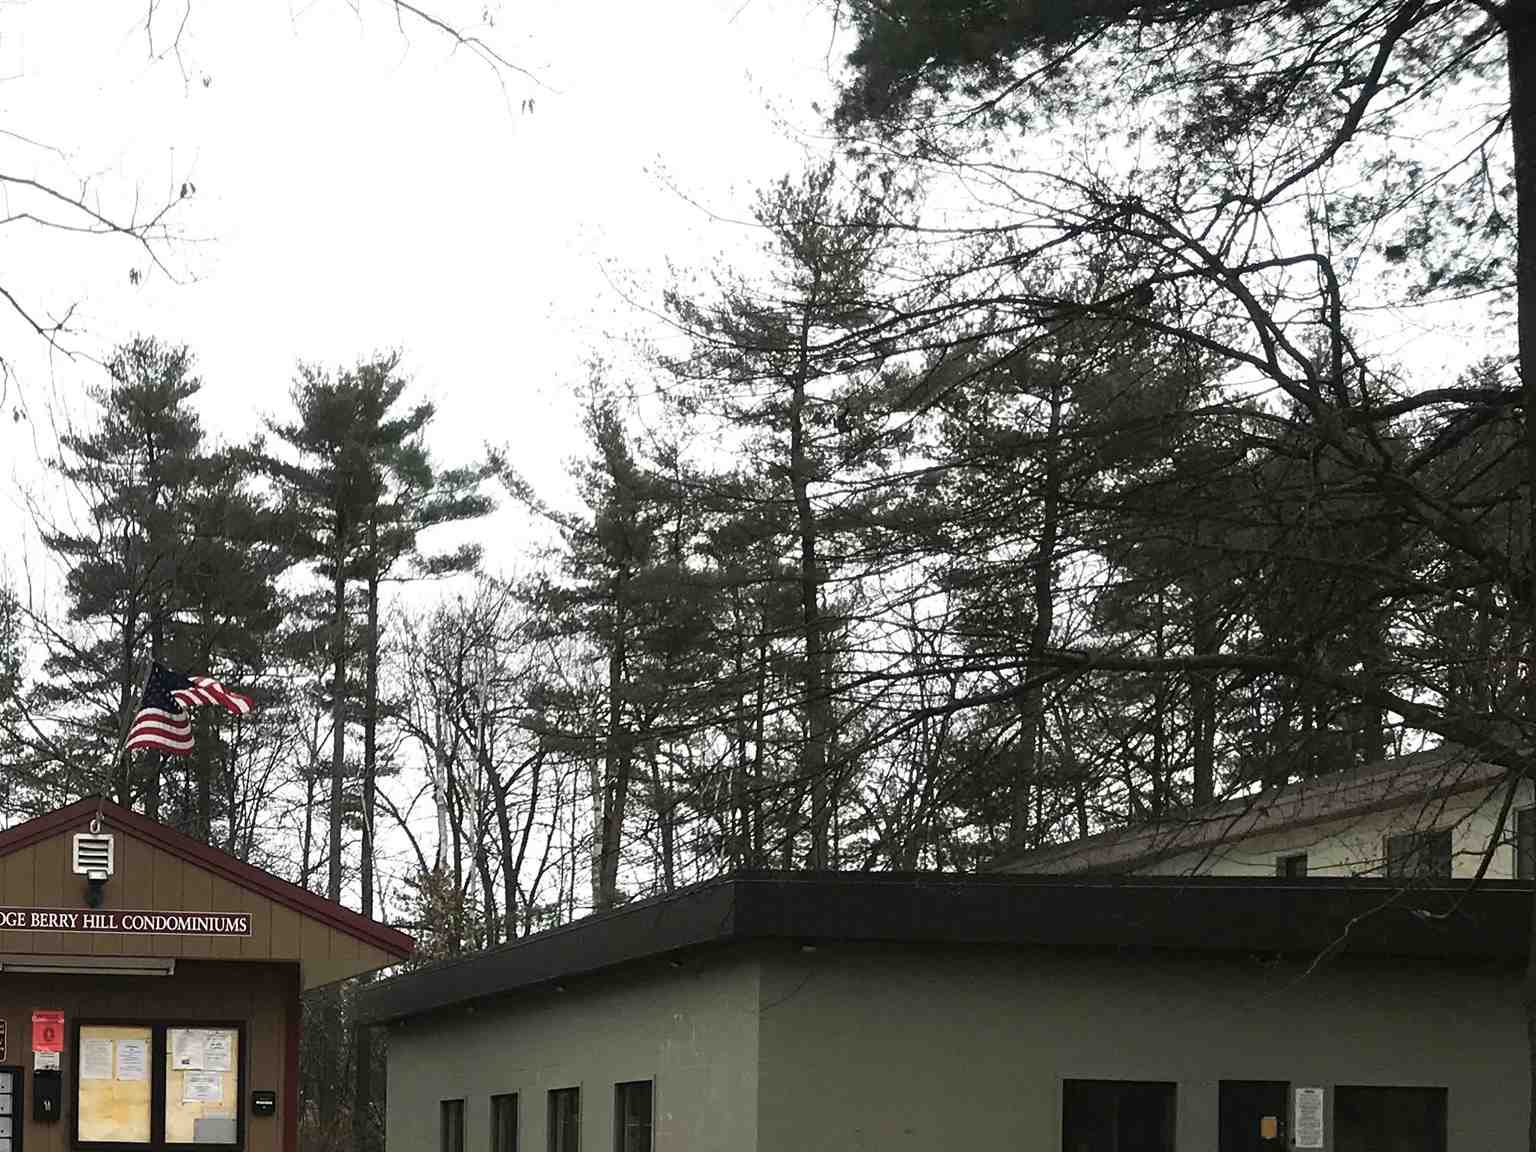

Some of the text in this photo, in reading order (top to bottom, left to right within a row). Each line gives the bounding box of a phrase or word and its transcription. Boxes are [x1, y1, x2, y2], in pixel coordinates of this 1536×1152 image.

[30, 913, 79, 929] BERRY
[83, 914, 118, 929] HILL
[121, 915, 248, 932] CONDOMINIUMS
